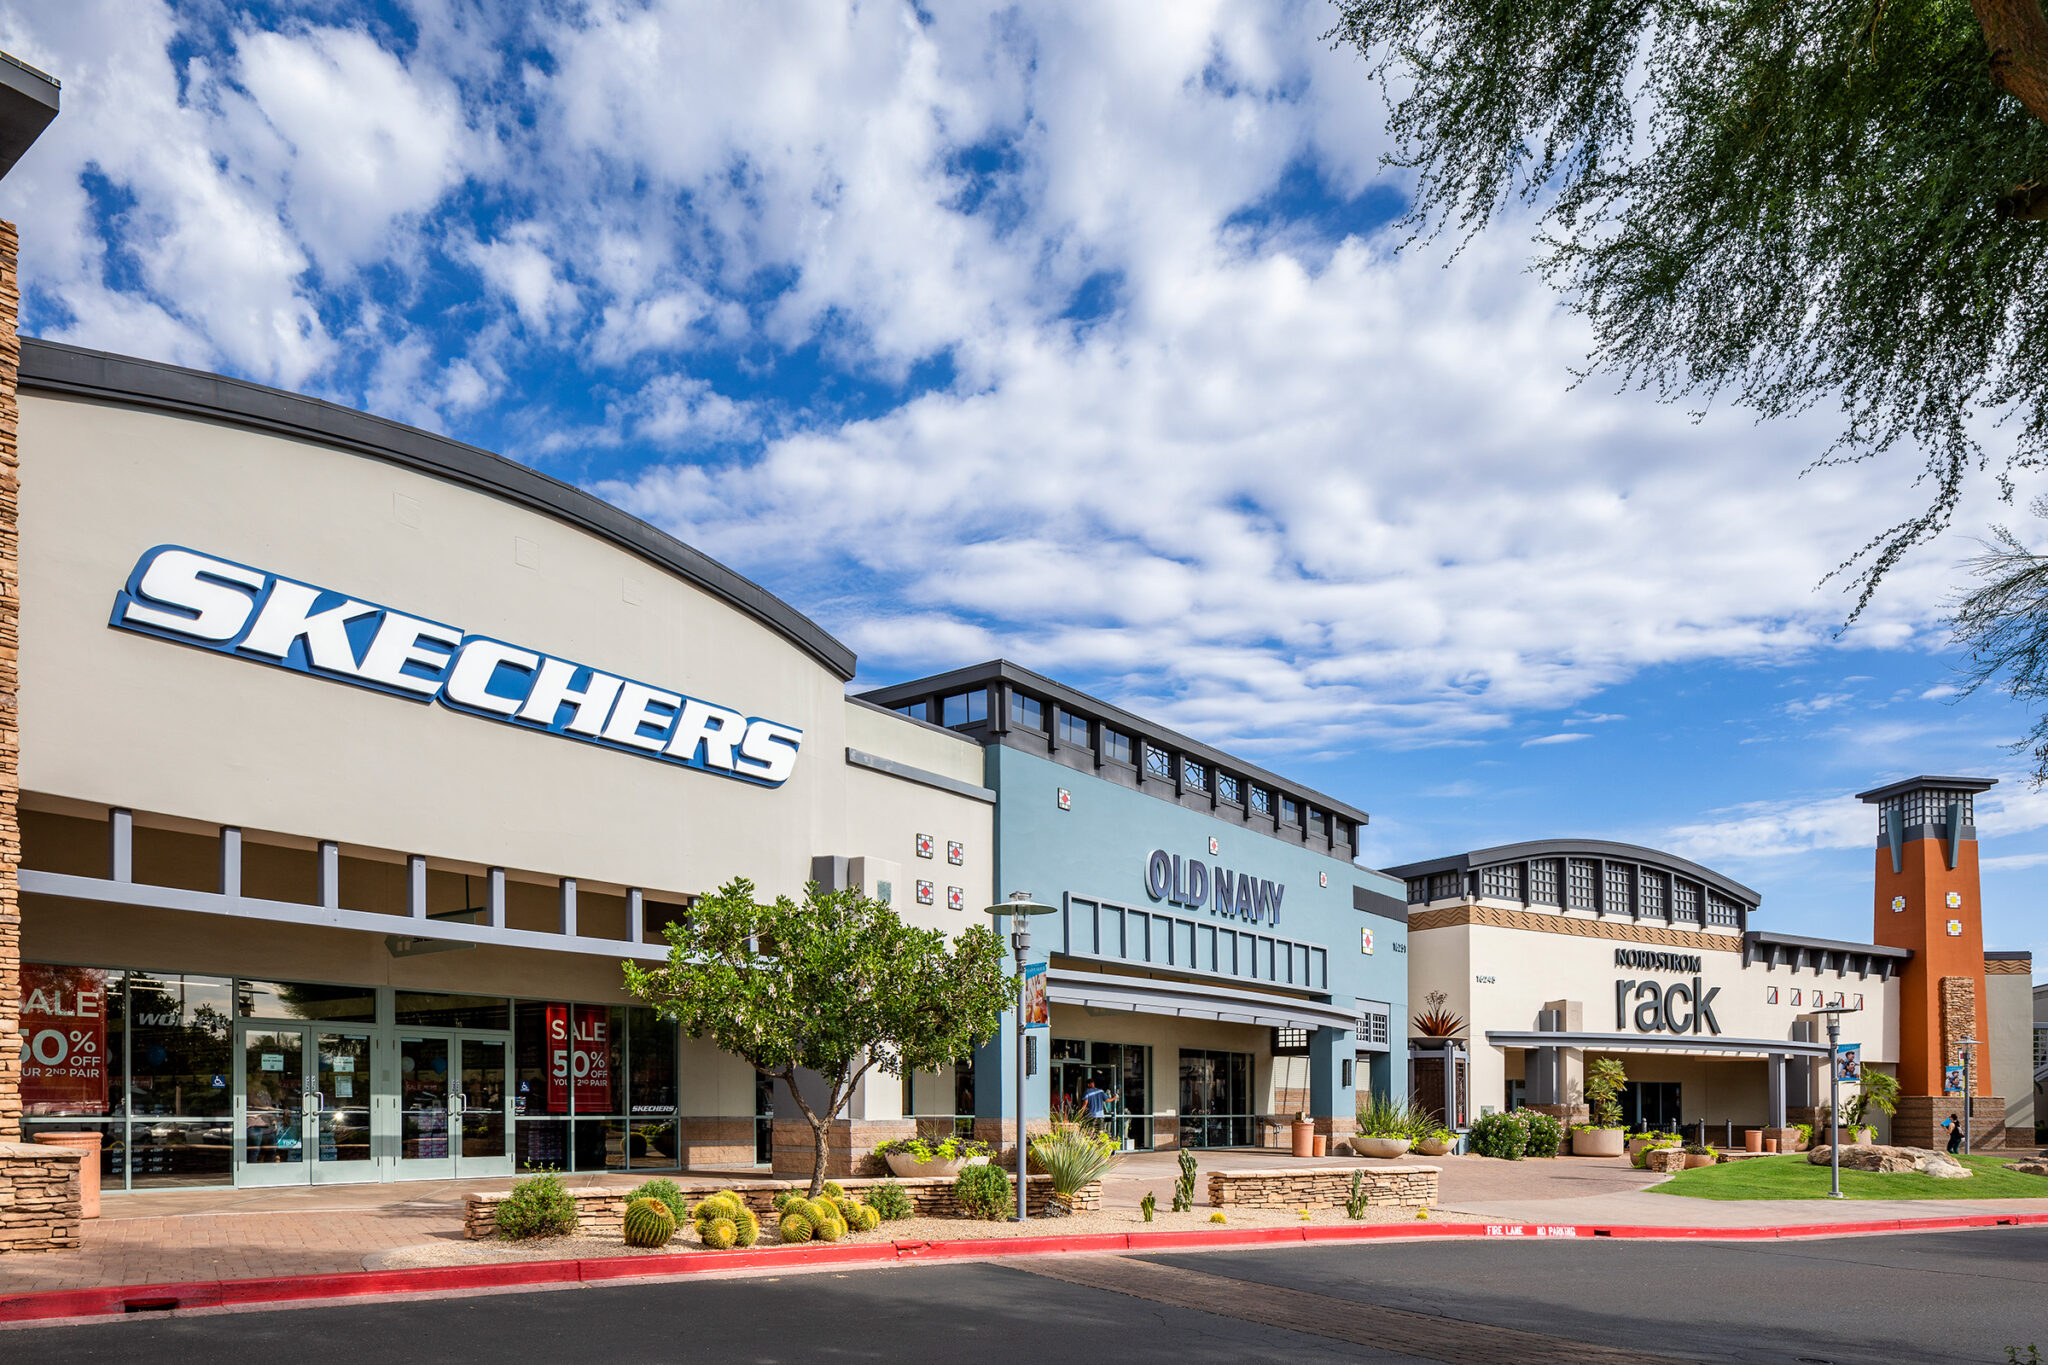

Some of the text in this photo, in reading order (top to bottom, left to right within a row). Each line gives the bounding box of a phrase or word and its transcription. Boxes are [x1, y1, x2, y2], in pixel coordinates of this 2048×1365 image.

[110, 545, 803, 788] SKECHERS
[1146, 849, 1285, 926] OLD NAVY
[1615, 948, 1702, 973] NORDSTROM
[19, 988, 99, 1018] ALE
[1615, 977, 1721, 1034] rack
[552, 1019, 606, 1041] SALE
[22, 1067, 100, 1078] UR 2ND PAIR
[70, 1055, 101, 1067] OFF
[553, 1050, 605, 1078] 50%
[577, 1079, 589, 1087] 2ND
[590, 1069, 608, 1079] OFF
[1487, 1225, 1576, 1236] FIRE LANE NO PARKING
